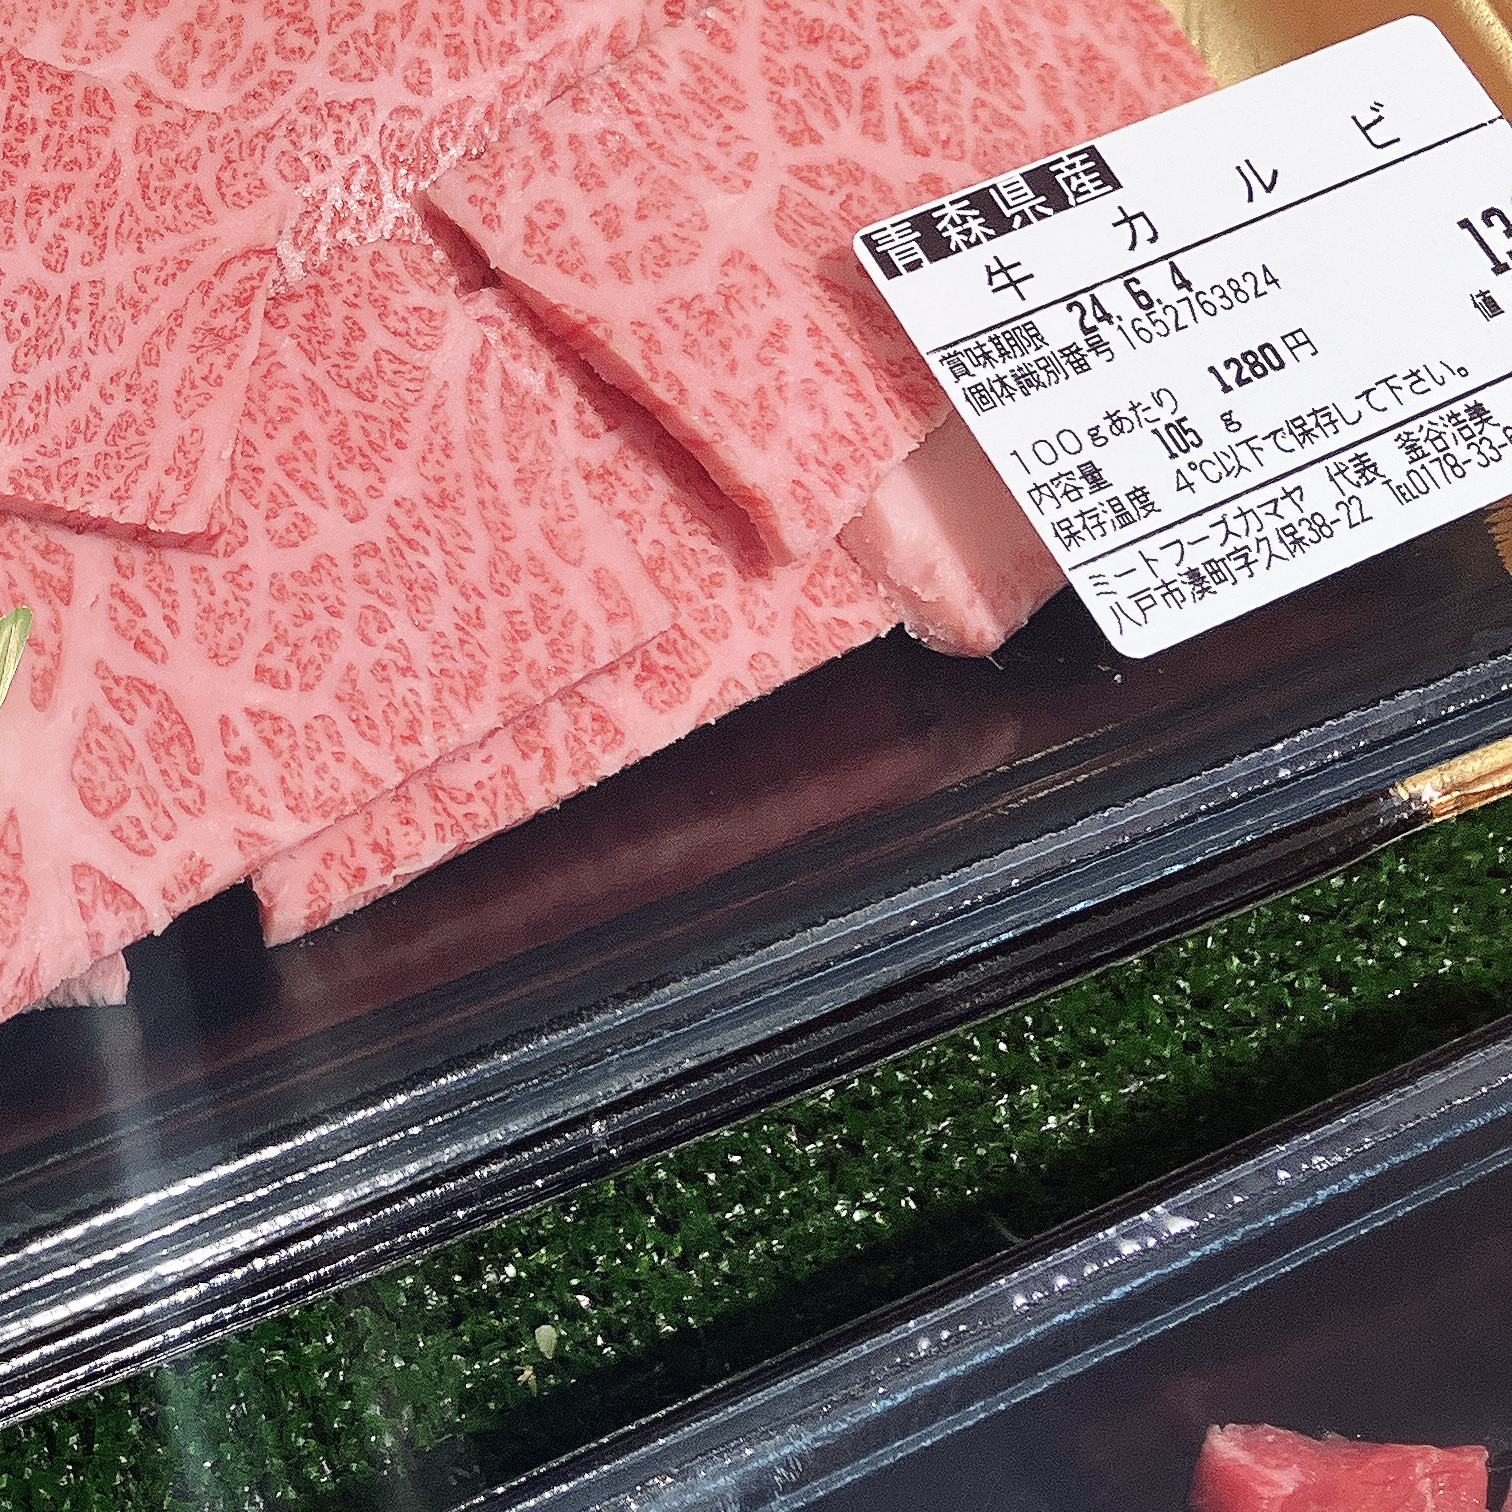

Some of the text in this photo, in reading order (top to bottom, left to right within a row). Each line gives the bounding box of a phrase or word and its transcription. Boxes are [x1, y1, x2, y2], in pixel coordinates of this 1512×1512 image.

[868, 150, 1115, 278] 青森県産
[1470, 289, 1505, 322] 値
[938, 320, 1049, 383] 賞味期限
[962, 334, 1116, 416] 個体識別番号
[1027, 460, 1114, 516] 内容量
[1151, 416, 1204, 461] 105
[1324, 451, 1387, 497] 代表
[1393, 399, 1501, 466] 釜谷浩美
[1051, 484, 1162, 553] 保存温度
